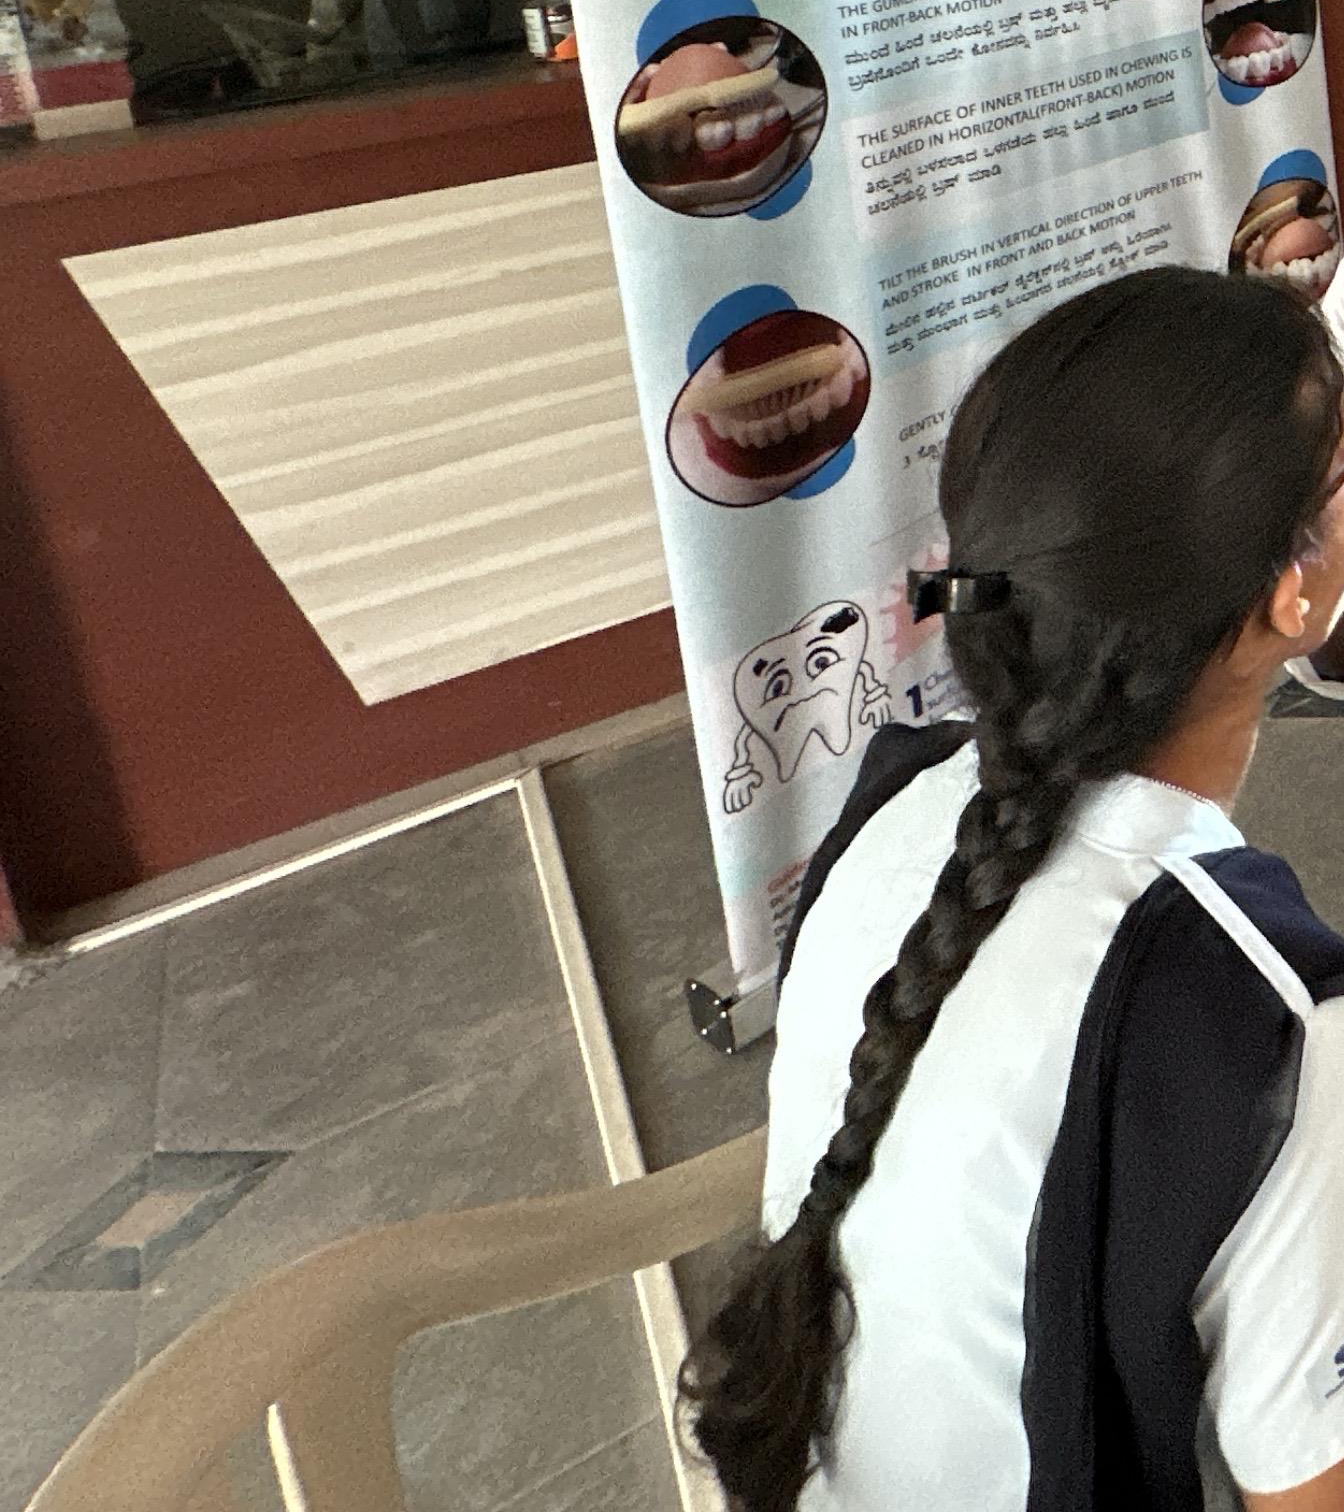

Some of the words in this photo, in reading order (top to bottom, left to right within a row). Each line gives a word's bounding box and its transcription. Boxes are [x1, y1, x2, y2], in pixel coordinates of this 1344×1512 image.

[838, 5, 868, 19] THE
[841, 25, 857, 38] IN
[862, 6, 943, 35] FRONT-BACK
[858, 130, 889, 148] THE
[892, 111, 951, 136] SURFACE
[956, 104, 977, 119] OF
[981, 92, 1022, 113] INNER
[1025, 81, 1065, 100] TEETH
[1070, 70, 1101, 89] USED
[1105, 65, 1119, 78] IN
[1121, 50, 1179, 76] CHEWING
[1181, 46, 1193, 60] IS
[862, 140, 925, 169] CLEANED
[929, 133, 944, 148] IN
[1127, 70, 1176, 92] MOTION
[880, 276, 903, 292] TILT
[906, 265, 928, 282] THE
[932, 248, 978, 273] BRUSH
[981, 242, 995, 256] IN
[998, 224, 1052, 252] VERTICAL
[1055, 200, 1115, 230] DIRECTION
[1118, 194, 1131, 208] OF
[1134, 183, 1171, 203] UPPER
[1170, 170, 1202, 191] TEETH
